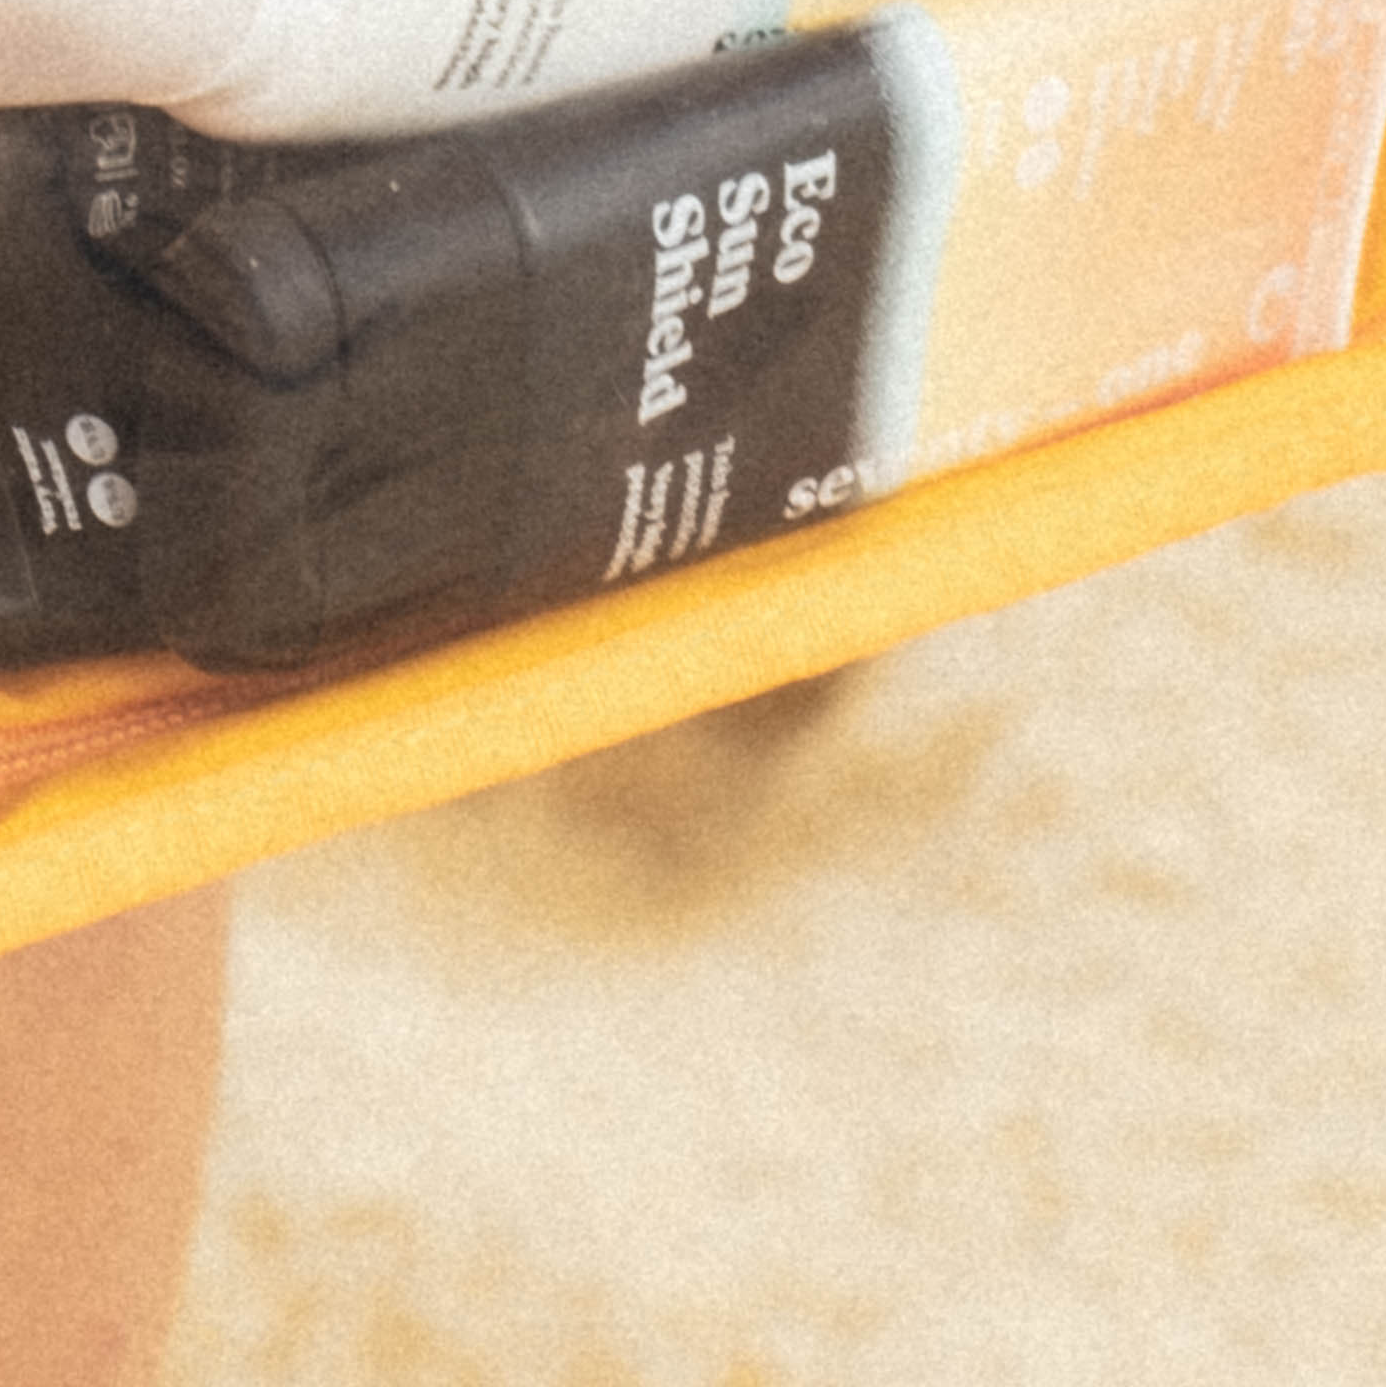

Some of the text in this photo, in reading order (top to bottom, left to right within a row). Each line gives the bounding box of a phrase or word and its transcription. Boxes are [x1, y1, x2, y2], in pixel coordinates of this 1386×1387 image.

[707, 172, 770, 319] Sun
[773, 148, 838, 284] Eco
[638, 193, 710, 426] Shield
